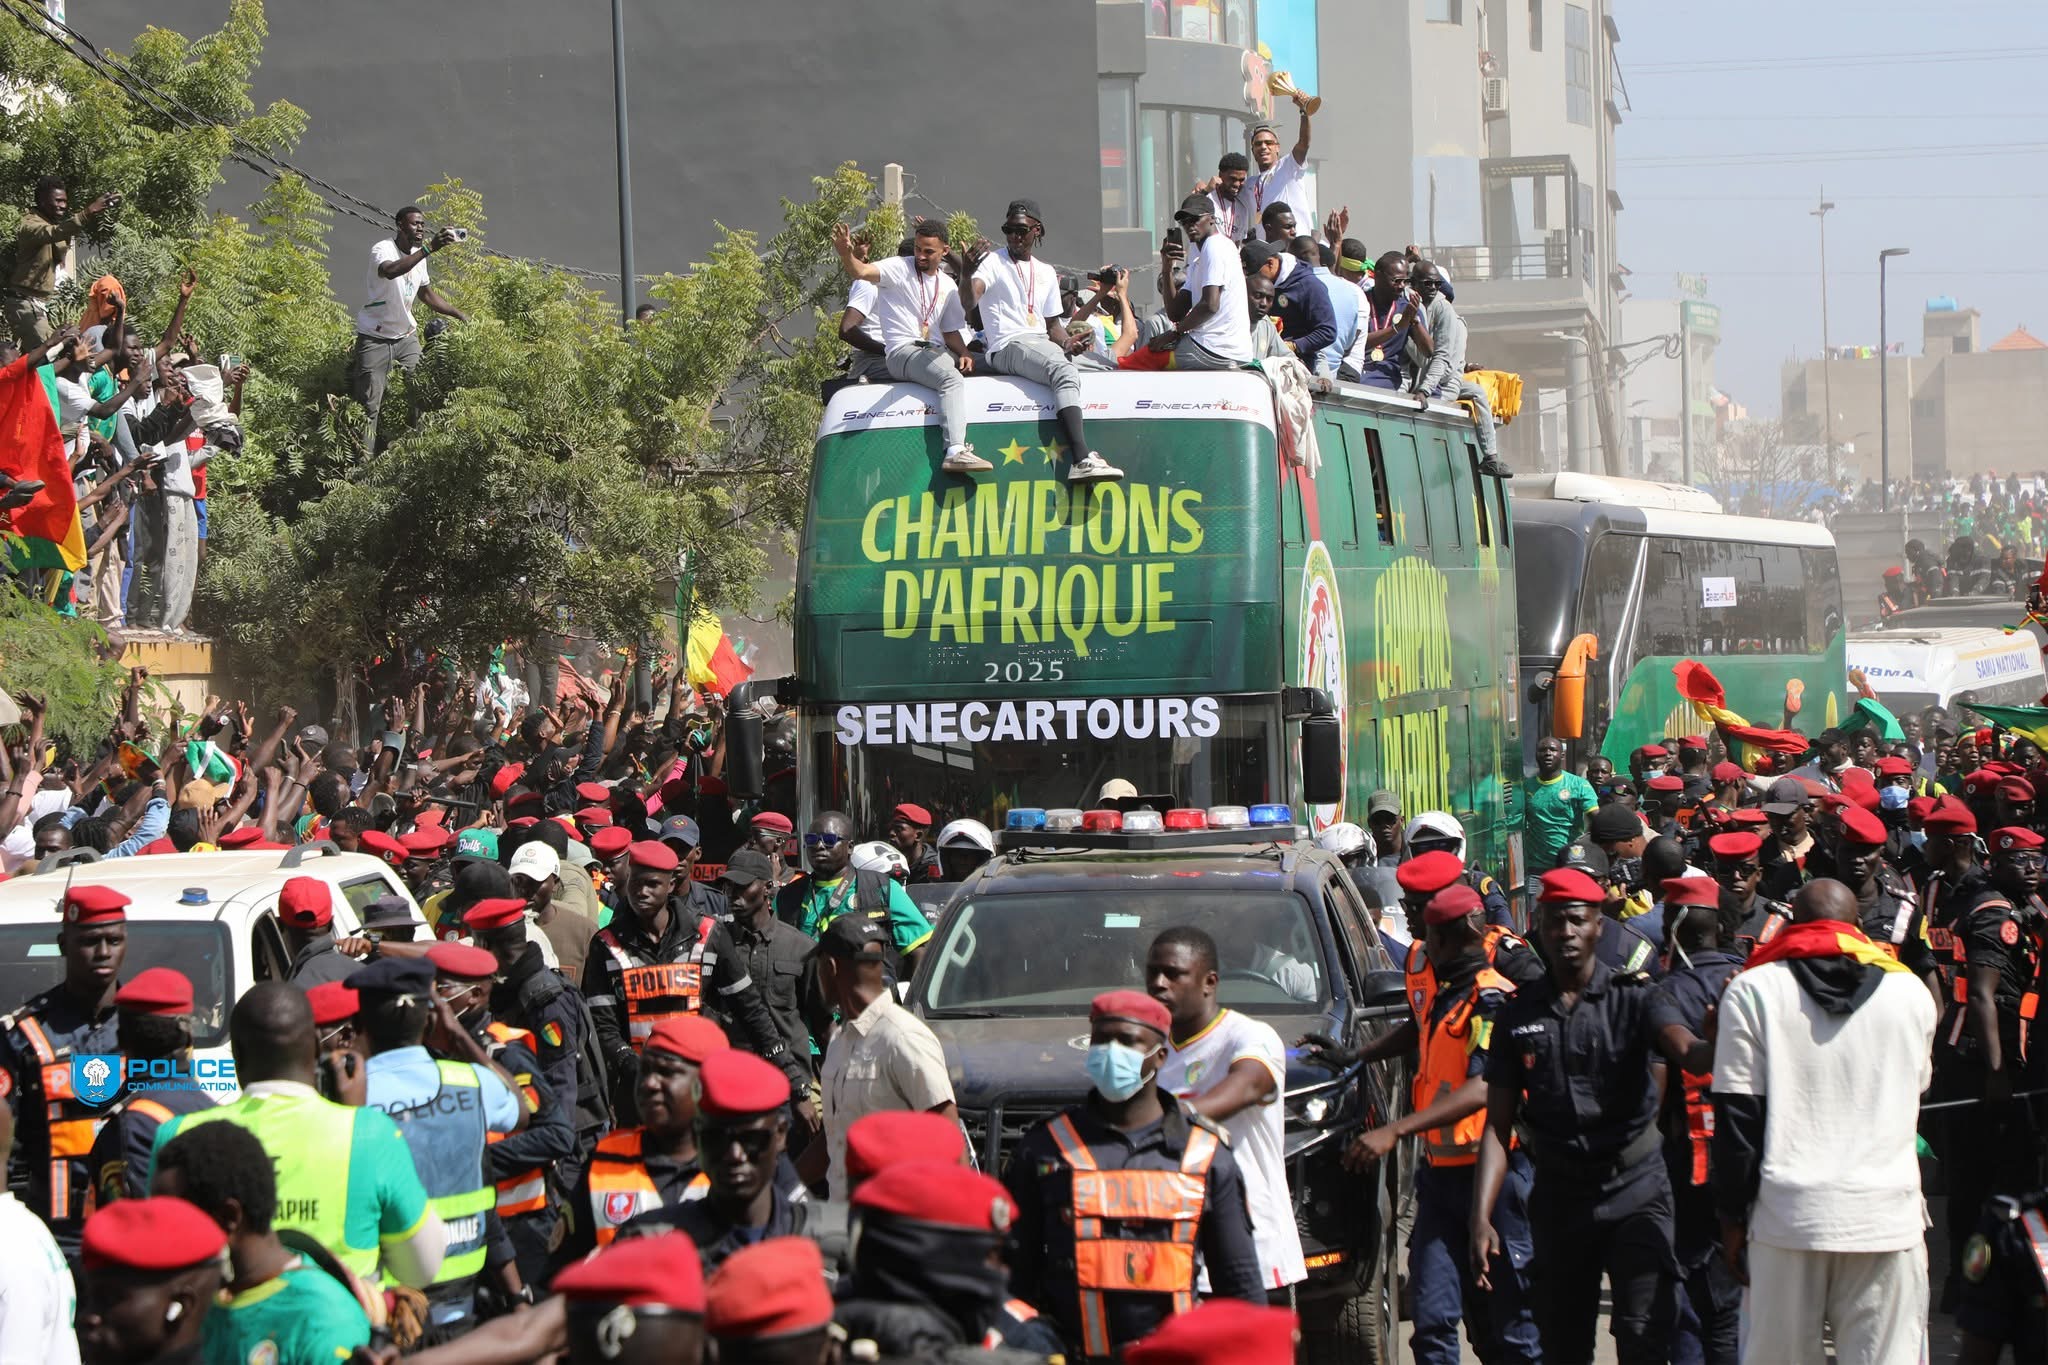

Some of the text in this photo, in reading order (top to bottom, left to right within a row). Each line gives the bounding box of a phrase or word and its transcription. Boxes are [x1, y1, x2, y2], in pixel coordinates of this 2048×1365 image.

[861, 480, 1204, 563] CHAMPIONS
[883, 562, 1176, 658] D'AFRIQUE
[984, 660, 1065, 682] 2025
[1975, 652, 2030, 678] SAMU NATIONAL
[835, 697, 1221, 746] SENECARTOURS
[459, 839, 481, 852] Bulls
[628, 968, 699, 994] POLICE
